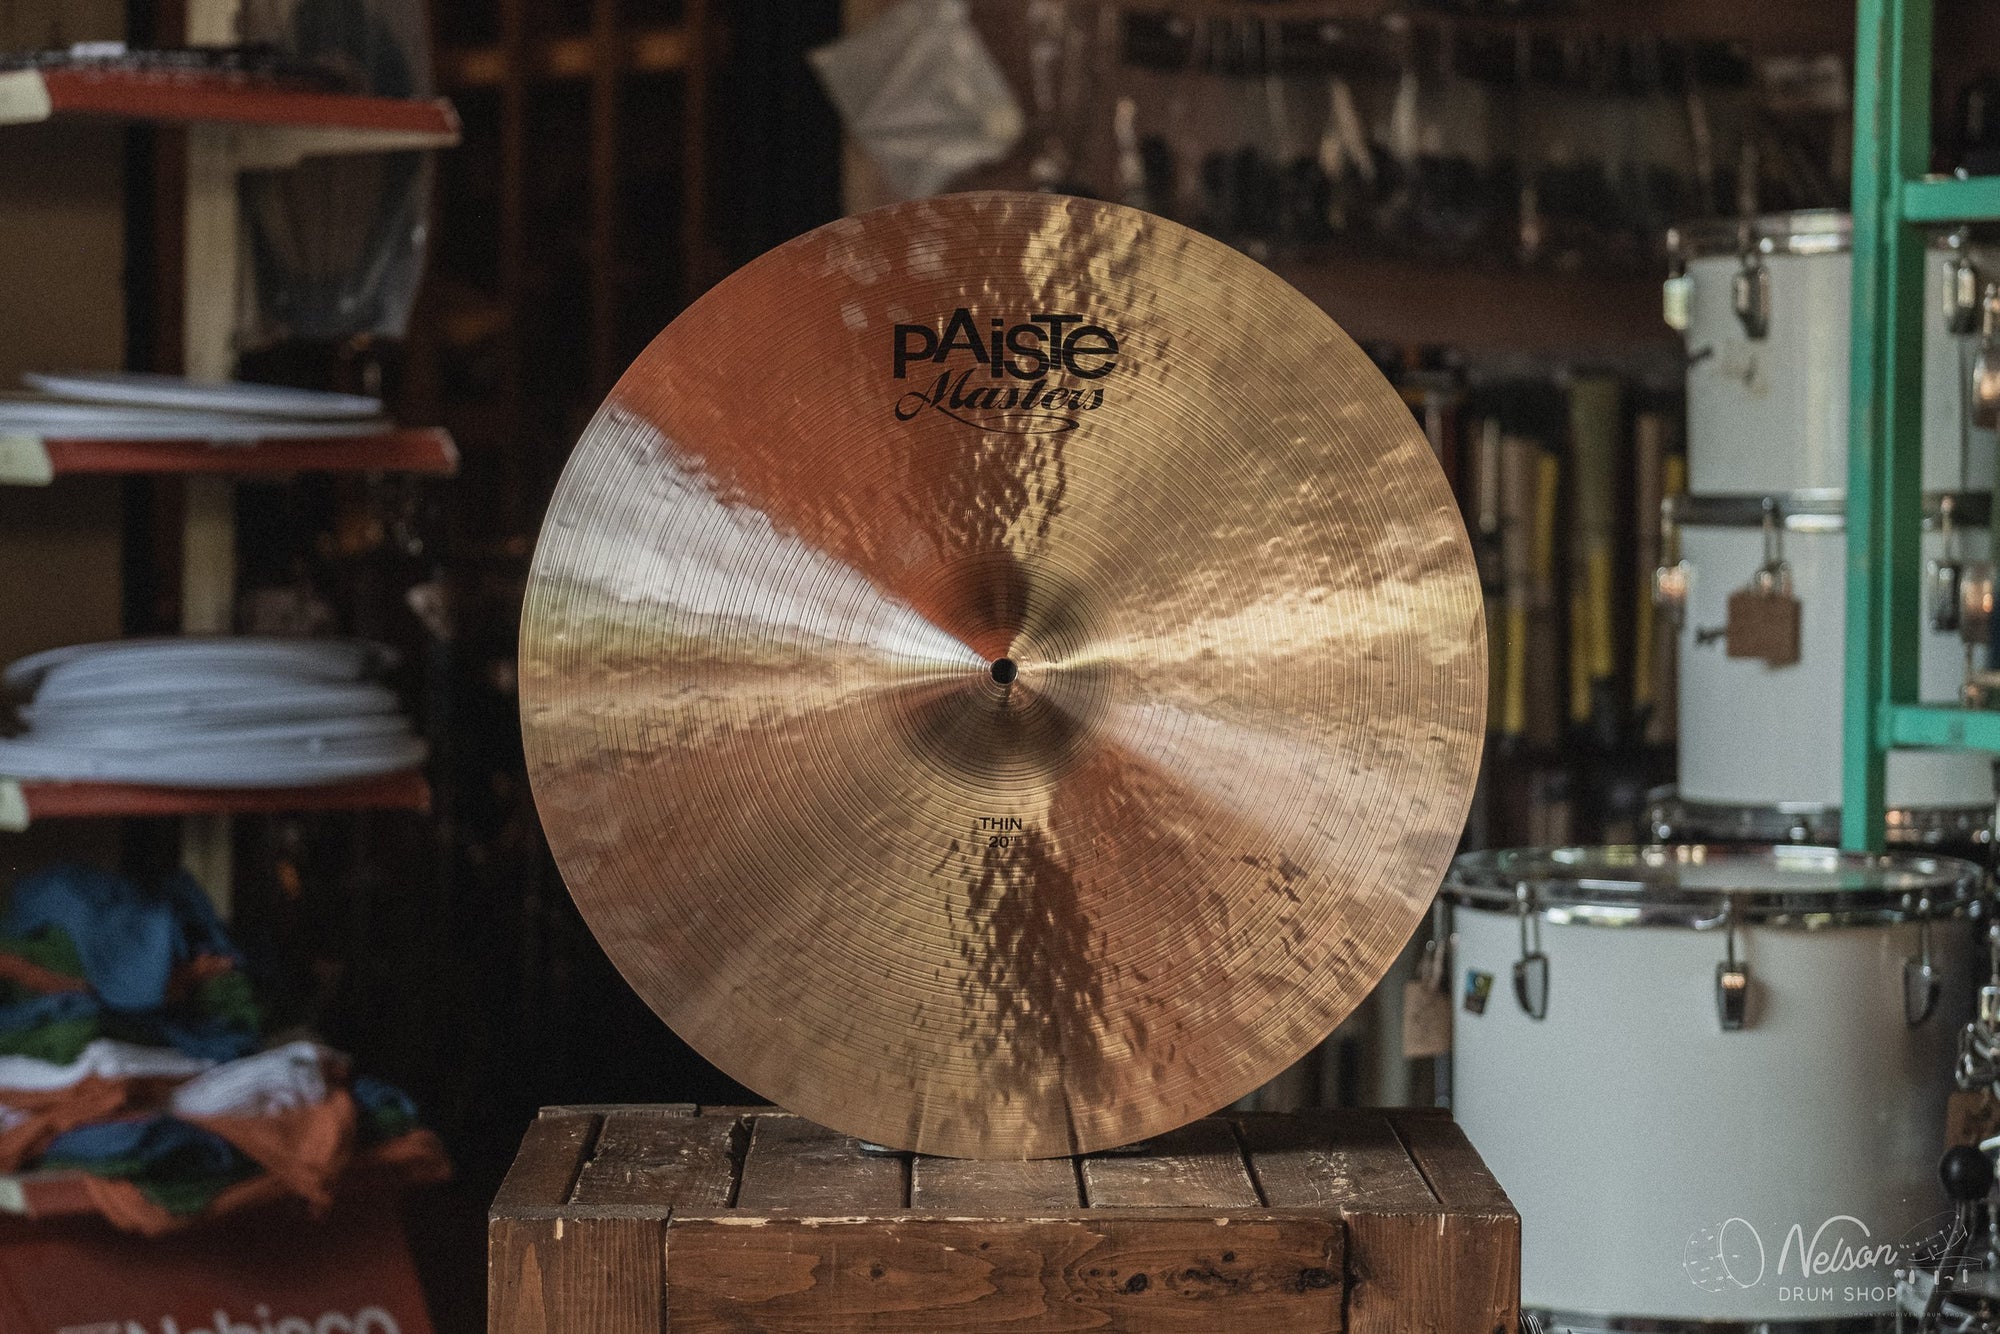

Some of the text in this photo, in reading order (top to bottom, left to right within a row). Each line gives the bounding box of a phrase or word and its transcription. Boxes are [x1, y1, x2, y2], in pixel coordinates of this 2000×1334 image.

[894, 367, 1104, 434] Masters
[979, 817, 1022, 830] THIN
[988, 835, 1017, 848] 20"
